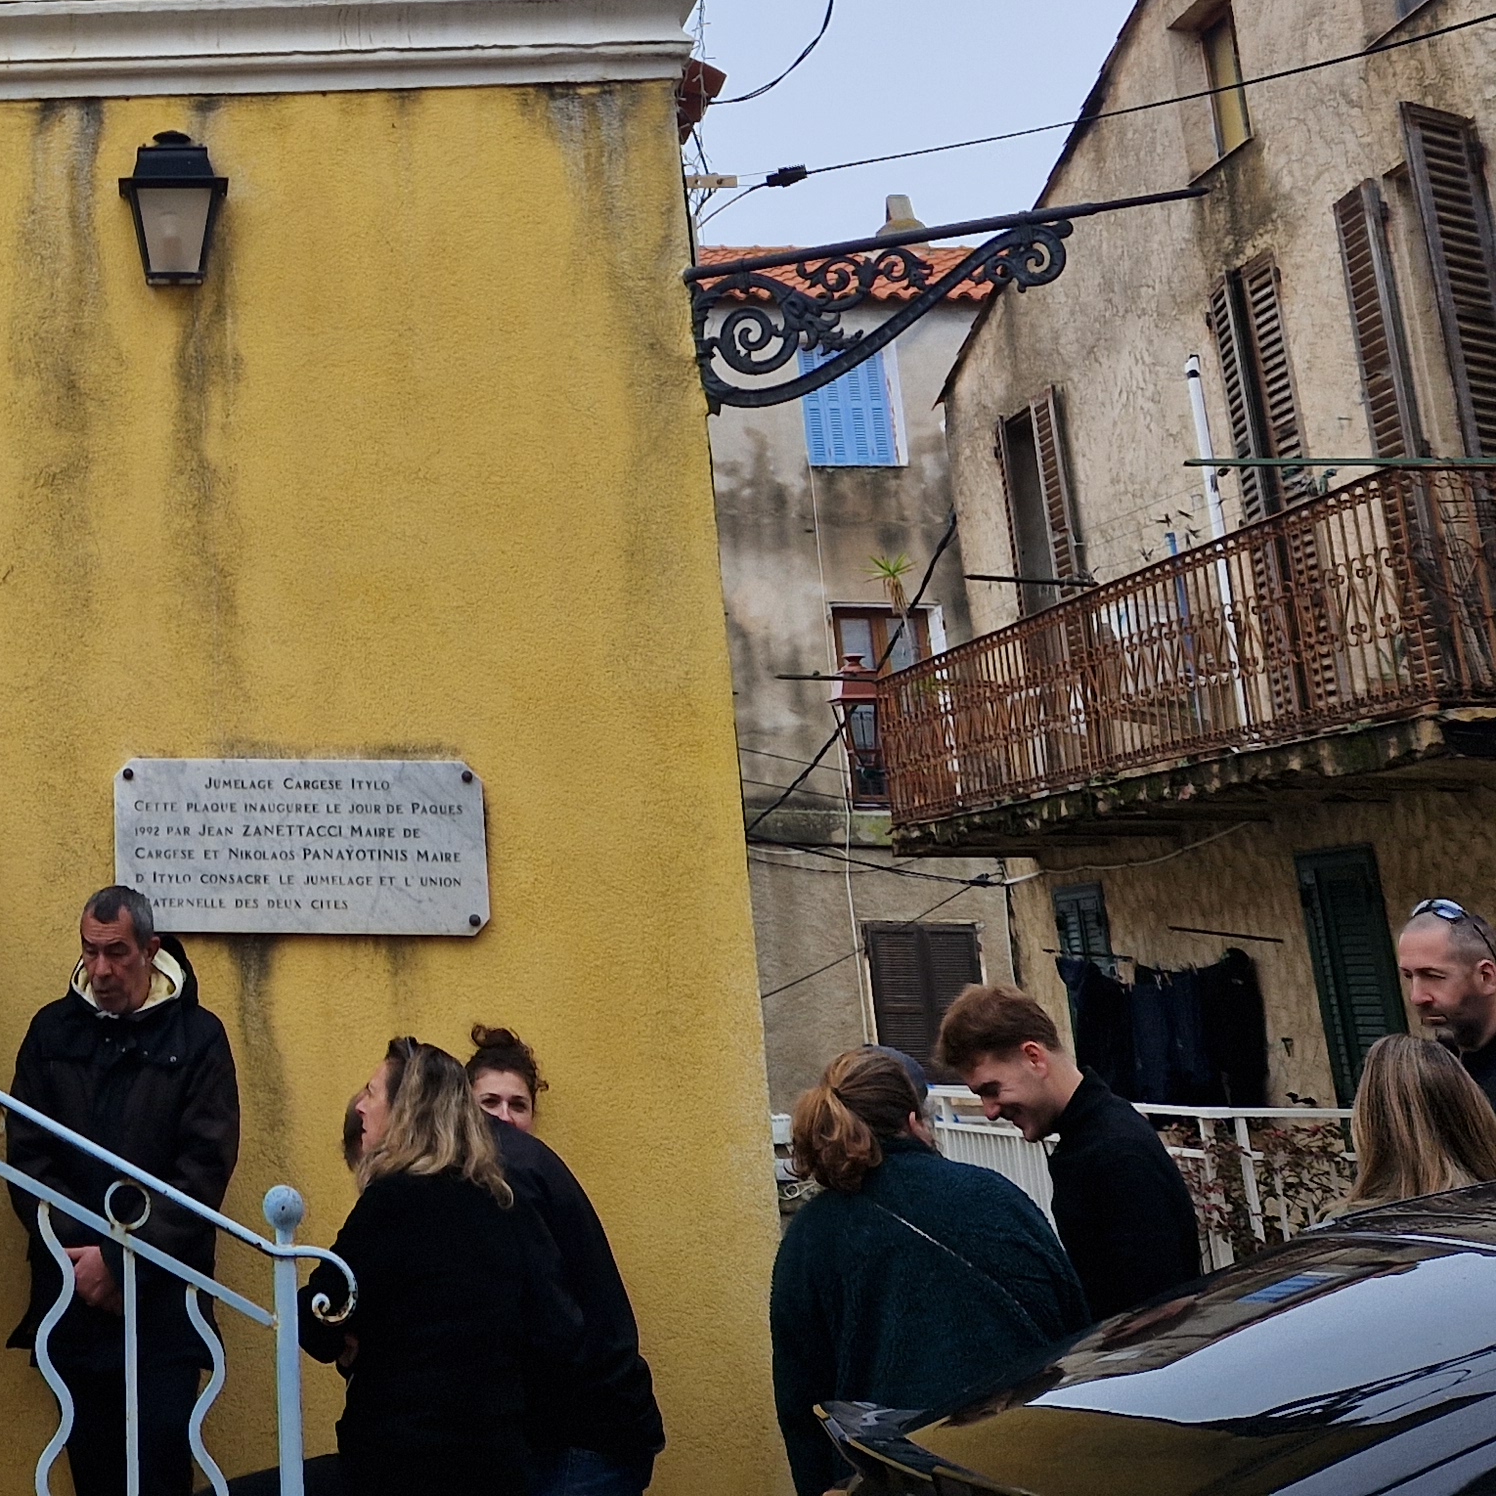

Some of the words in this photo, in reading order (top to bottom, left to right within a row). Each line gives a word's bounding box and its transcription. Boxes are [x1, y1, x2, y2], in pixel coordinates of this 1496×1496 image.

[205, 777, 274, 790] JUMELAGE
[283, 778, 342, 790] CARGESE
[351, 778, 390, 791] ITYLO
[134, 800, 178, 812] CETTE
[187, 802, 237, 813] PLAQUE
[244, 802, 320, 814] INAUGUREE
[326, 804, 342, 814] LE
[348, 803, 382, 815] JOUR
[386, 804, 404, 815] DE
[411, 802, 463, 815] PAQUES
[134, 826, 160, 837] 1992
[166, 826, 191, 837] PAR
[198, 824, 234, 837] JEAN
[242, 824, 342, 838] ZANETTACCI
[350, 825, 395, 839] MAIRE
[403, 827, 421, 839] DE
[204, 849, 220, 860] ET
[228, 847, 295, 861] NIKOLAOS
[303, 847, 408, 863] PANAYOTINIS
[416, 849, 462, 863] MAIRE
[152, 871, 192, 885] ITYLO
[200, 873, 270, 885] CONSACRE
[279, 874, 295, 885] LE
[303, 874, 373, 886] JUMELAGE
[379, 875, 396, 887] ET
[420, 876, 462, 888] UNION
[149, 897, 226, 909] ATERNELLE
[235, 898, 259, 909] DES
[267, 898, 302, 910] DEUX
[311, 899, 348, 910] CITES
